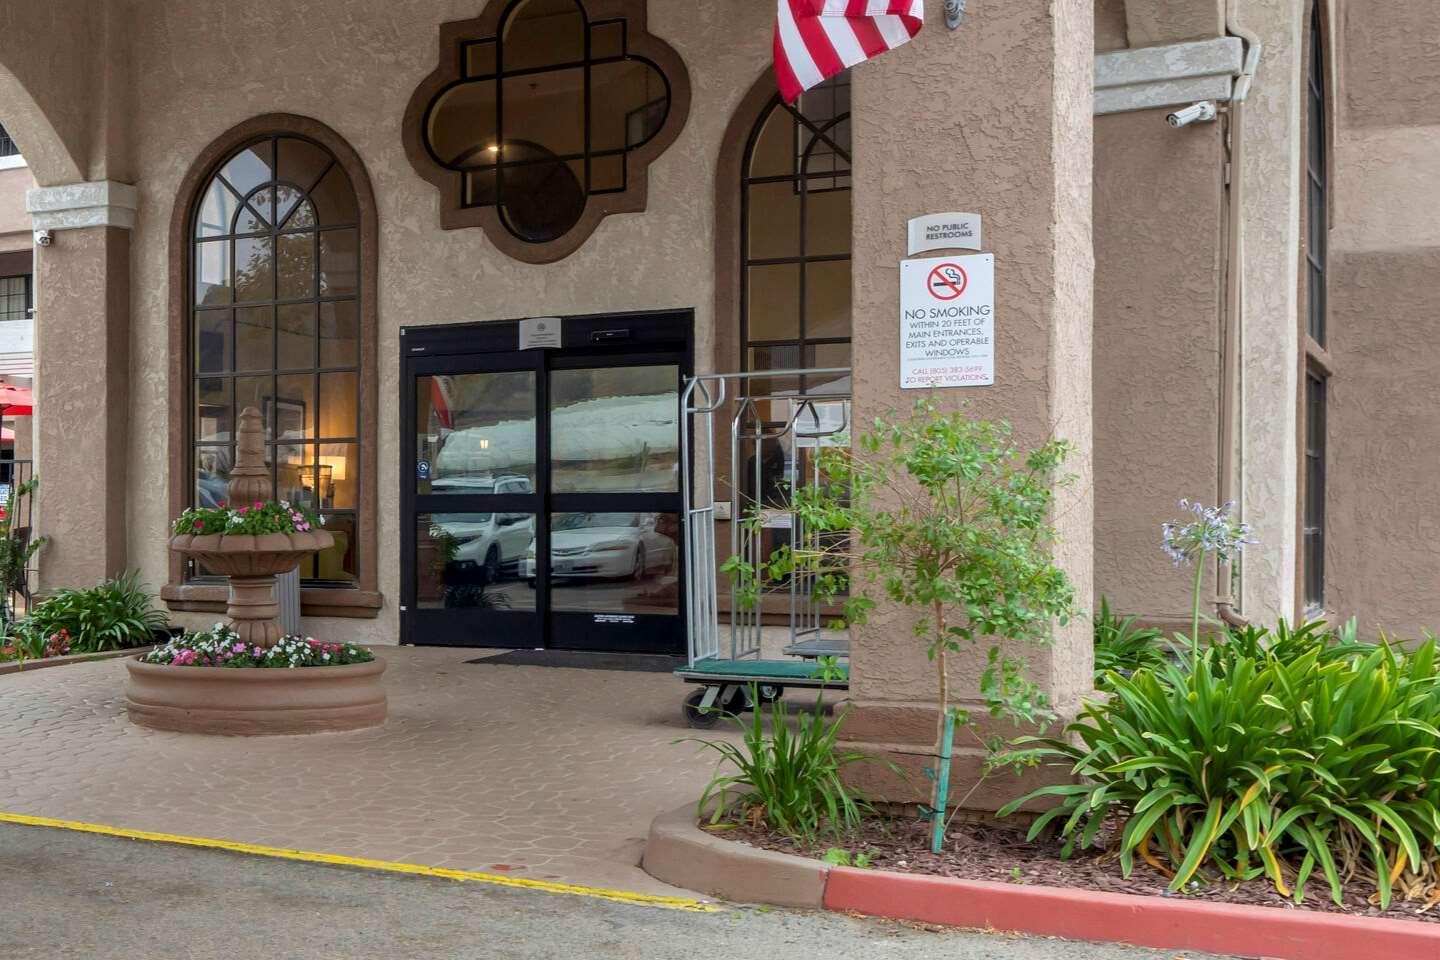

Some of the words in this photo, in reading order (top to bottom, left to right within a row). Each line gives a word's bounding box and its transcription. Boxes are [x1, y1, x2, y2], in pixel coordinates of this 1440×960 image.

[927, 224, 941, 232] NO
[942, 222, 969, 231] PUBLIC
[926, 230, 972, 239] RESTROOMS
[905, 308, 926, 320] NO
[929, 305, 991, 319] SMOKING
[909, 321, 940, 329] WITHIN
[941, 320, 952, 328] 20
[954, 319, 972, 327] FEET
[973, 318, 986, 326] OF
[908, 330, 931, 339] MAIN
[906, 340, 927, 349] EXITS
[949, 337, 989, 346] OPERABLE
[924, 348, 970, 357] WINDOWS
[918, 375, 943, 383] REPORT
[944, 373, 989, 382] VIOLATIONS
